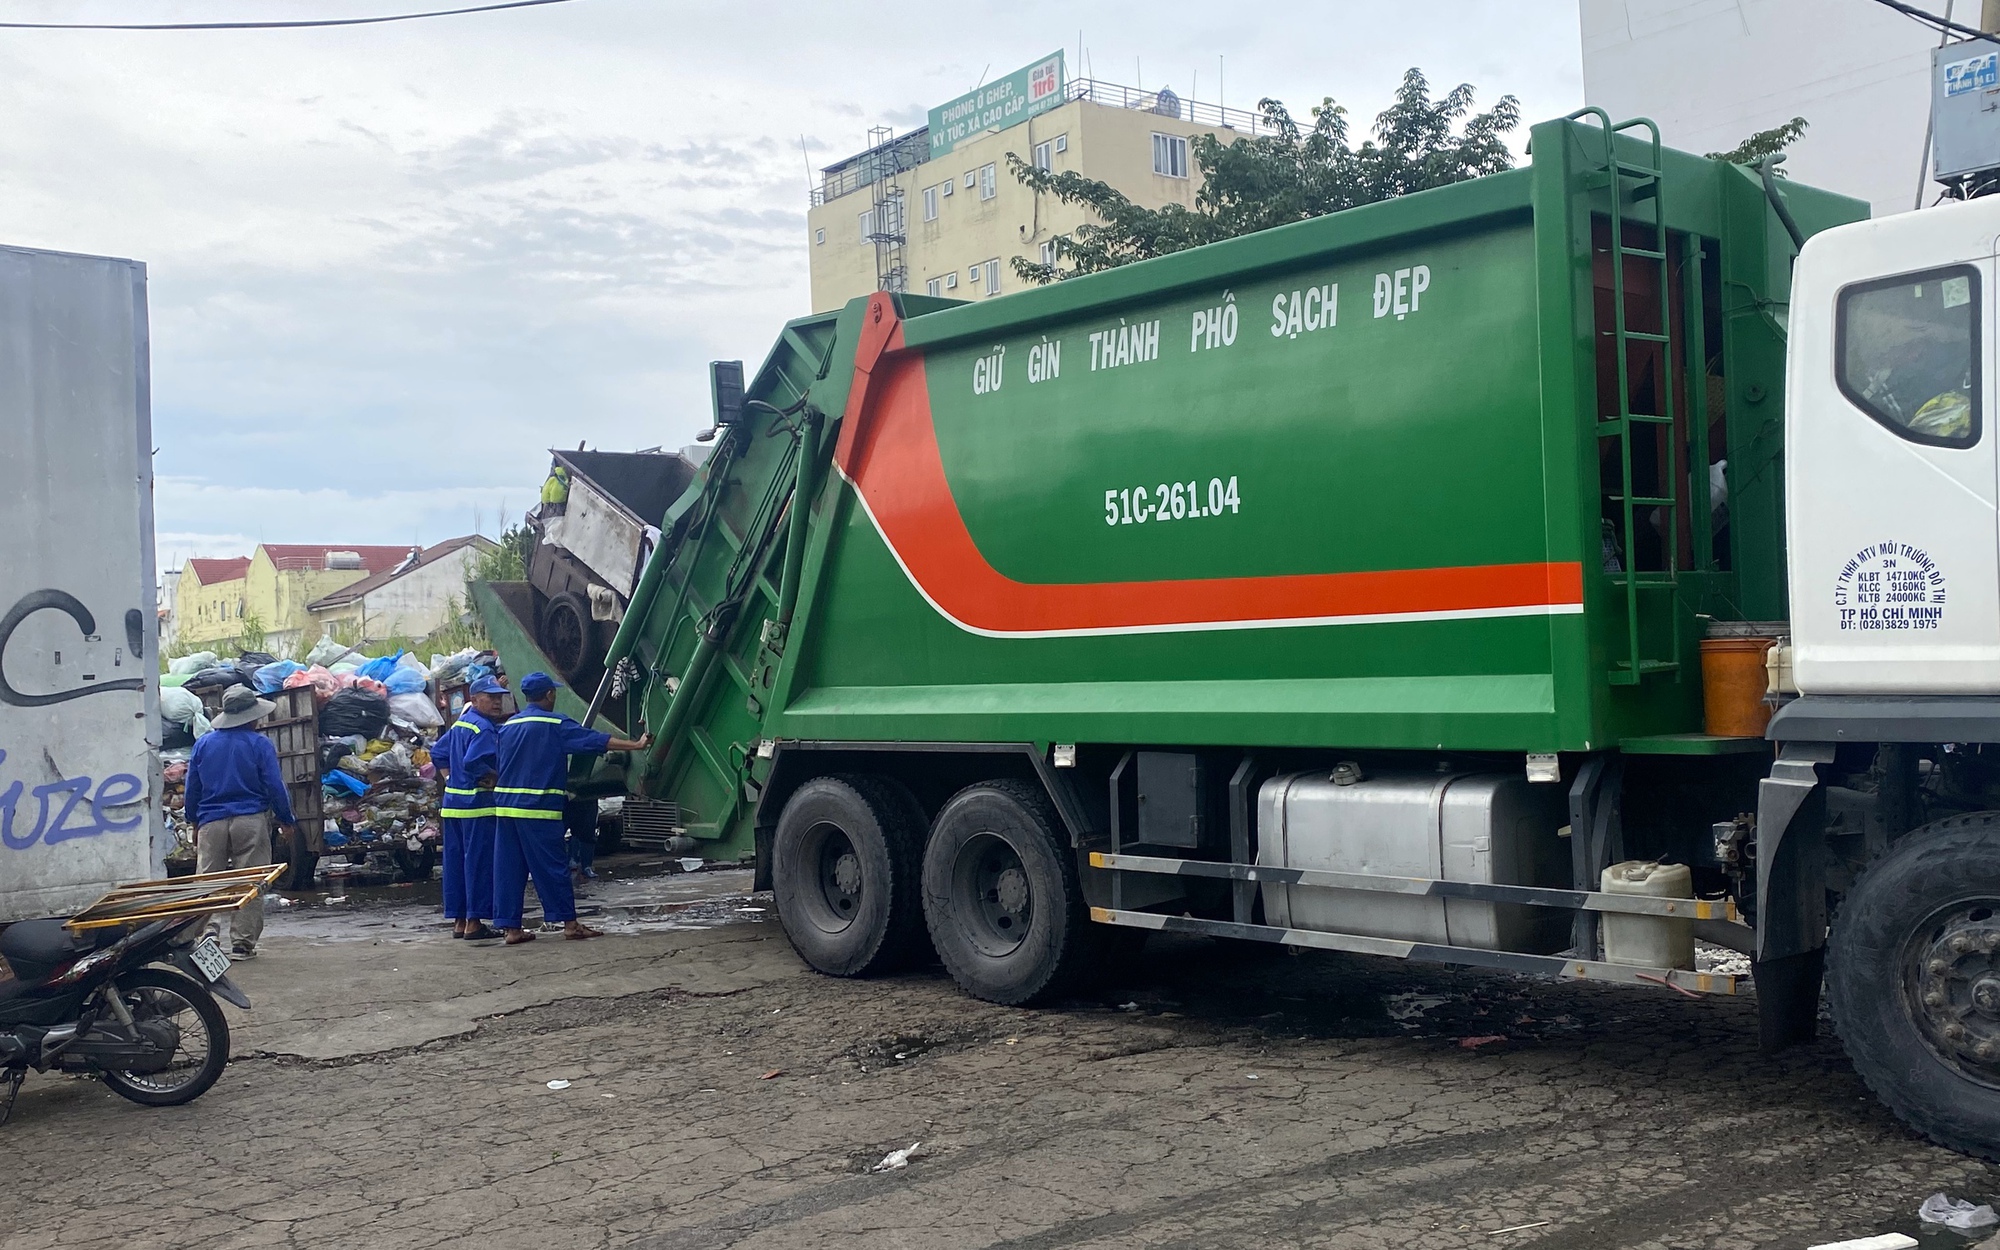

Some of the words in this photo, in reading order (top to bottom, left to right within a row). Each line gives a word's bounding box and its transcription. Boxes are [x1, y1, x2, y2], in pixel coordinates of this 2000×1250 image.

[942, 99, 974, 125] PHÒNG
[947, 122, 965, 142] TÚC
[983, 106, 1002, 126] CAO
[1005, 92, 1025, 116] CẤP
[973, 344, 1006, 395] GIỮ
[1027, 335, 1061, 384] GÌN
[1089, 318, 1160, 372] THÀNH
[1190, 289, 1239, 353] PHỐ
[1270, 283, 1339, 340] SẠCH
[1373, 265, 1431, 321] ĐẸP
[1105, 475, 1241, 526] 51C-261.04
[1838, 558, 1860, 583] TNHH
[1856, 545, 1877, 564] MTV
[1879, 539, 1898, 555] MÔI
[1882, 559, 1897, 569] 3N
[1858, 571, 1881, 582] KLBT
[1886, 570, 1926, 582] 14710KG
[1858, 582, 1881, 593] KLCC
[1891, 581, 1926, 592] 9160KG
[1858, 592, 1881, 603] KLTB
[1885, 591, 1926, 603] 24000KG
[1840, 609, 1856, 620] TP
[1860, 603, 1878, 620] HỒ
[1882, 604, 1904, 620] CHÍ
[1908, 607, 1942, 619] MINH
[1840, 620, 1856, 630] ĐT:
[1859, 619, 1910, 631] (028)3829
[1913, 619, 1938, 629] 1975
[206, 955, 228, 979] 6207
